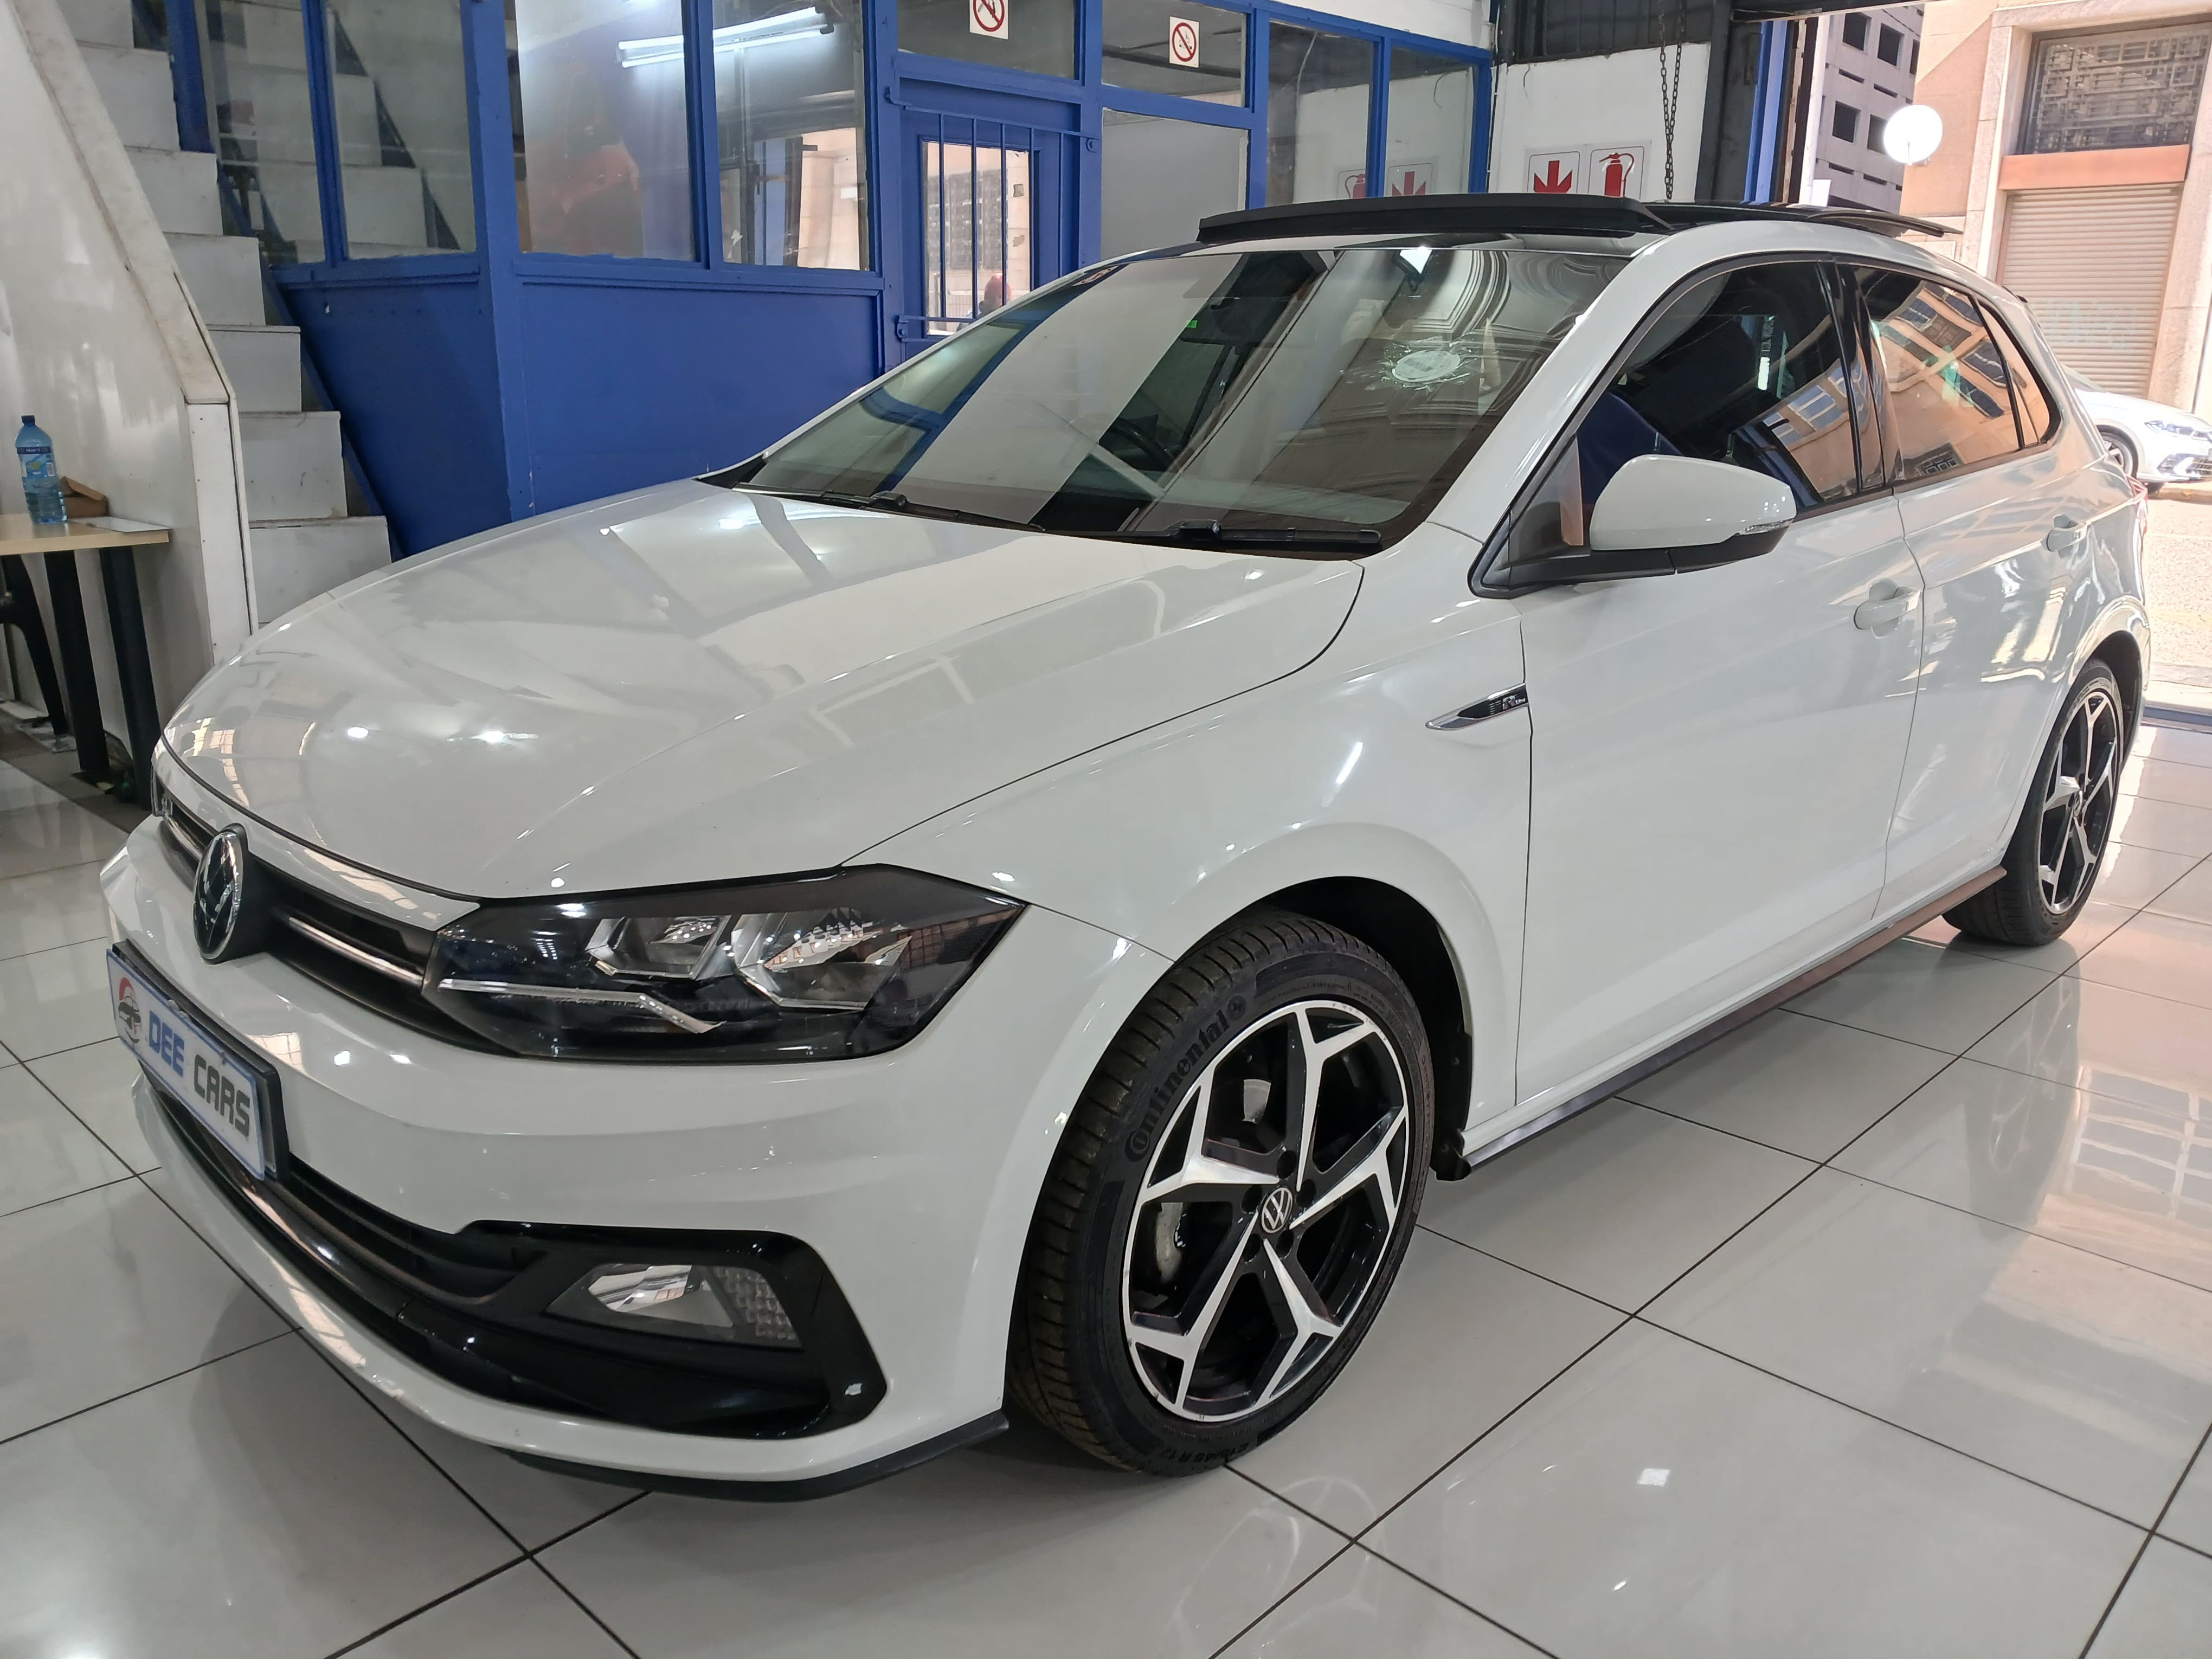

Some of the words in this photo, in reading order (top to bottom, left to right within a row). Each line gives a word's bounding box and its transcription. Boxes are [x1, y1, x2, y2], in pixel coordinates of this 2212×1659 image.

[149, 1011, 184, 1076] DEE
[194, 1054, 250, 1137] CARS
[1124, 1009, 1230, 1162] Continental
